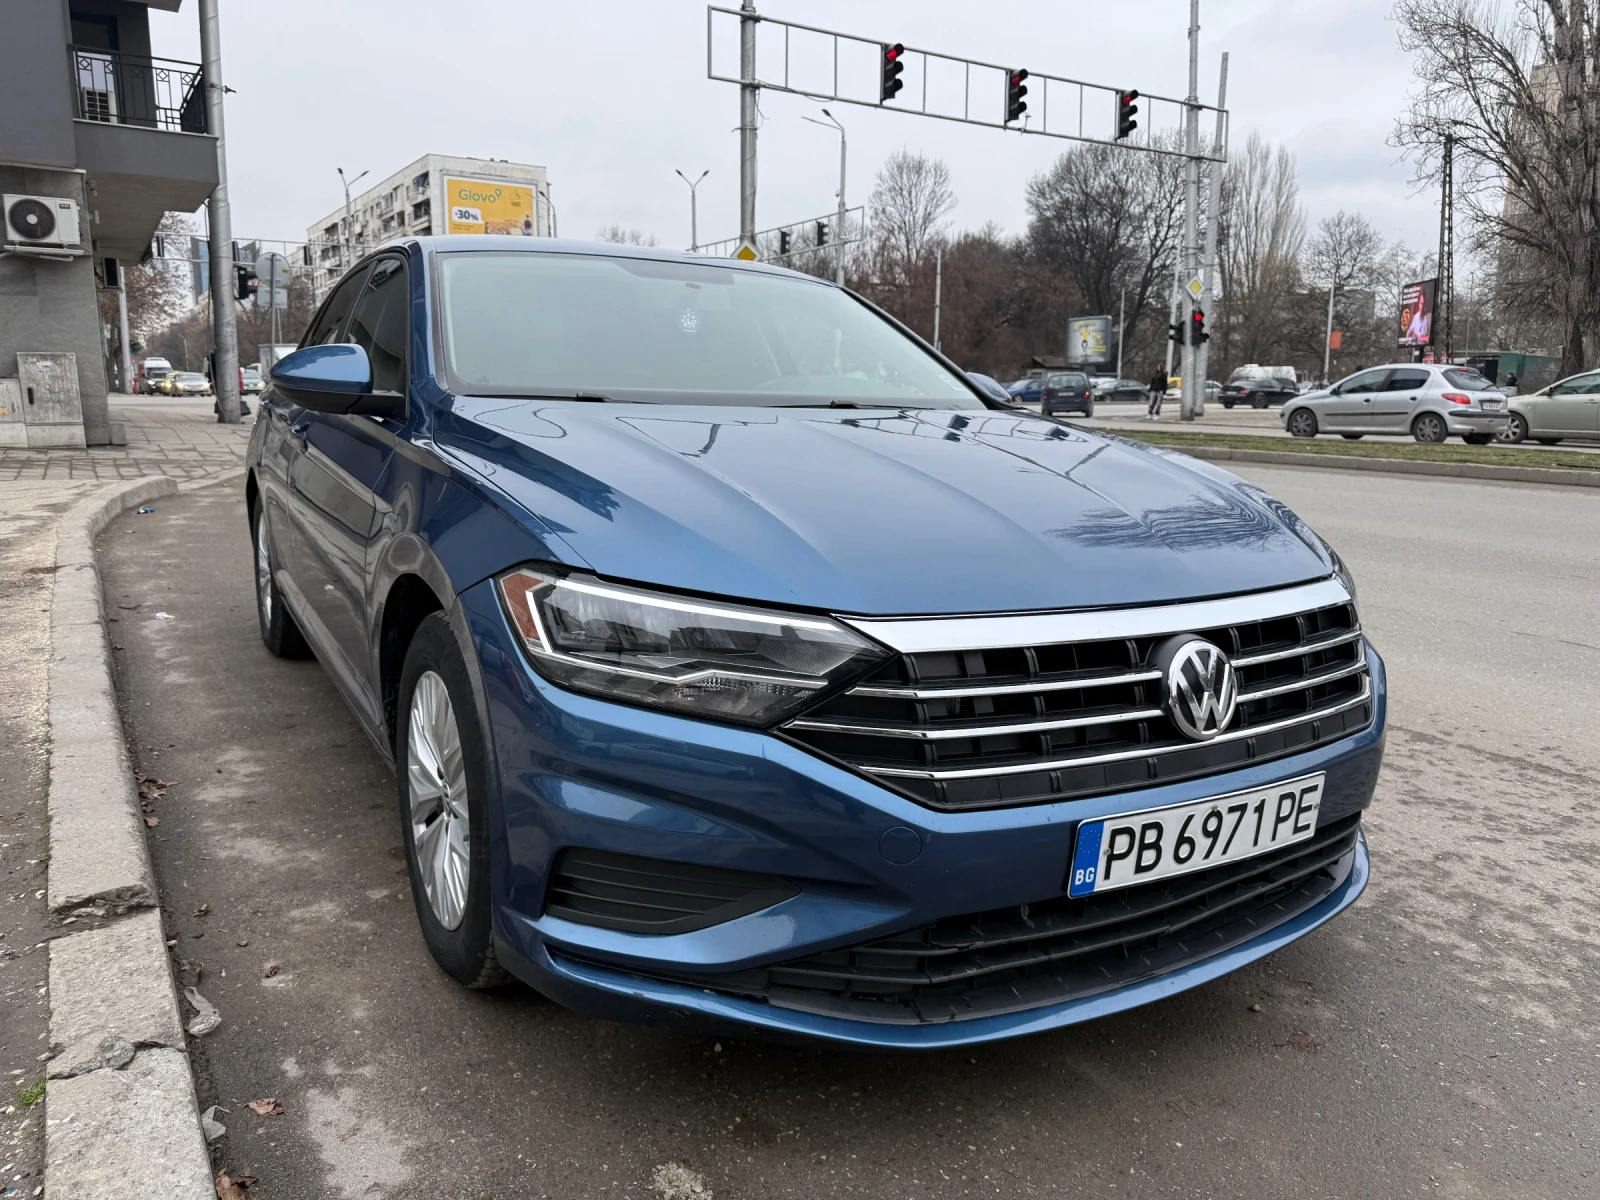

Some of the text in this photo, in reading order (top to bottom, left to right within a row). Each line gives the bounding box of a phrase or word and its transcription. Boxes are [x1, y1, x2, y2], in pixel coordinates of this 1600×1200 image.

[458, 189, 498, 204] Glovo
[454, 209, 479, 221] -30%
[1103, 784, 1319, 881] PB 6971 PE
[1074, 867, 1095, 886] BG
